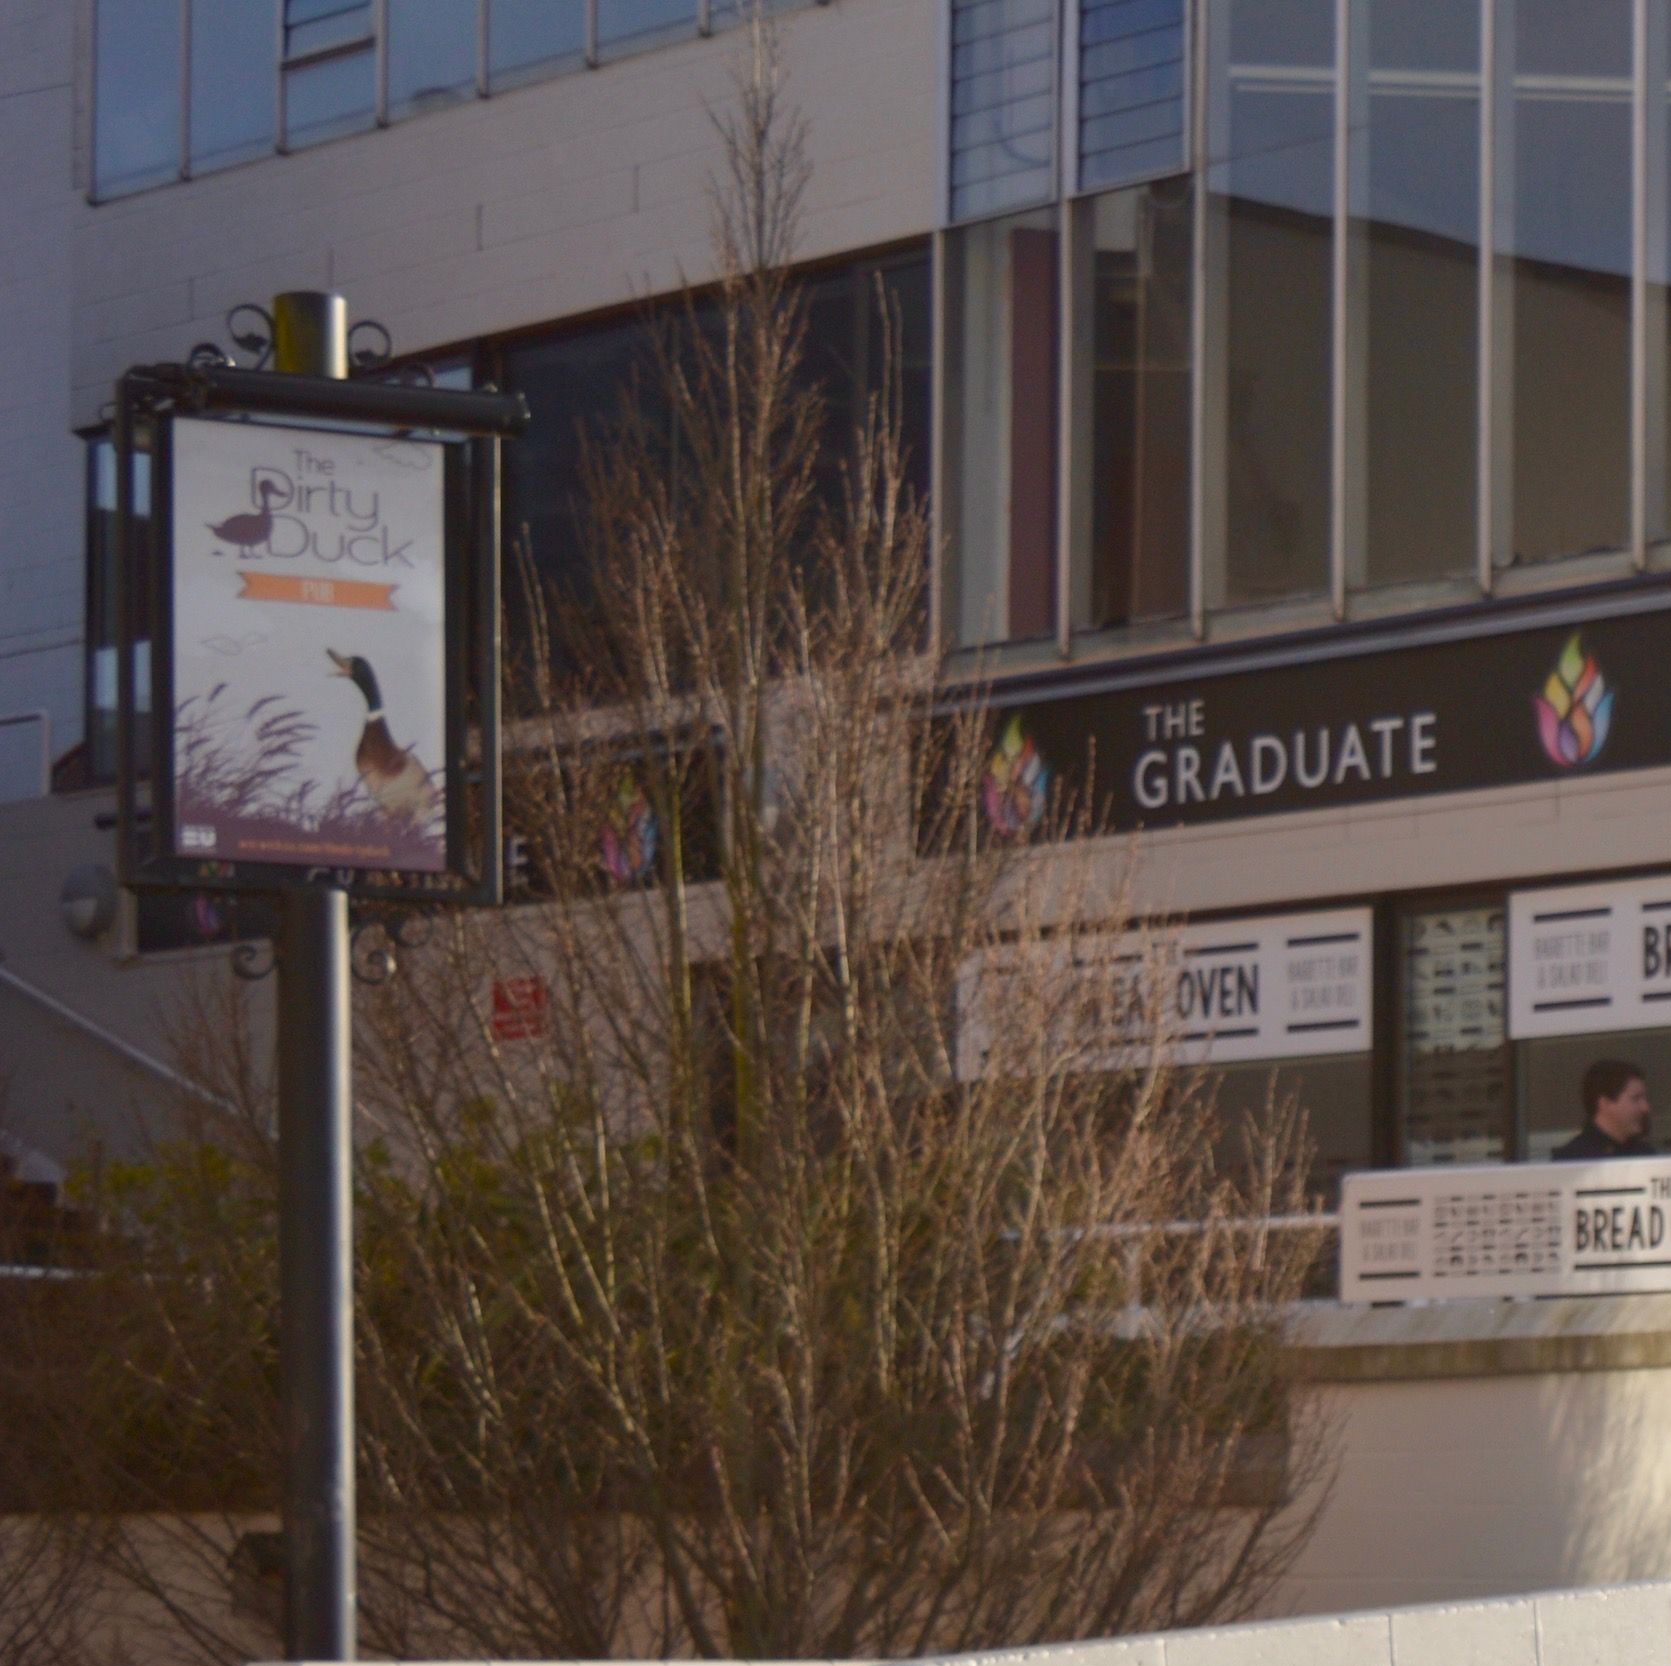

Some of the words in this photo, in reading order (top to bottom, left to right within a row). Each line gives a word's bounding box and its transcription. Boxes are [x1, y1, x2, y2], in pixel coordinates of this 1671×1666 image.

[294, 448, 336, 476] The
[252, 466, 379, 533] Dirty
[267, 513, 415, 570] Duck
[1143, 701, 1205, 742] THE
[1134, 713, 1438, 809] GRADUATE
[1176, 964, 1260, 1020] OVEN
[1575, 1205, 1665, 1254] BREAD
